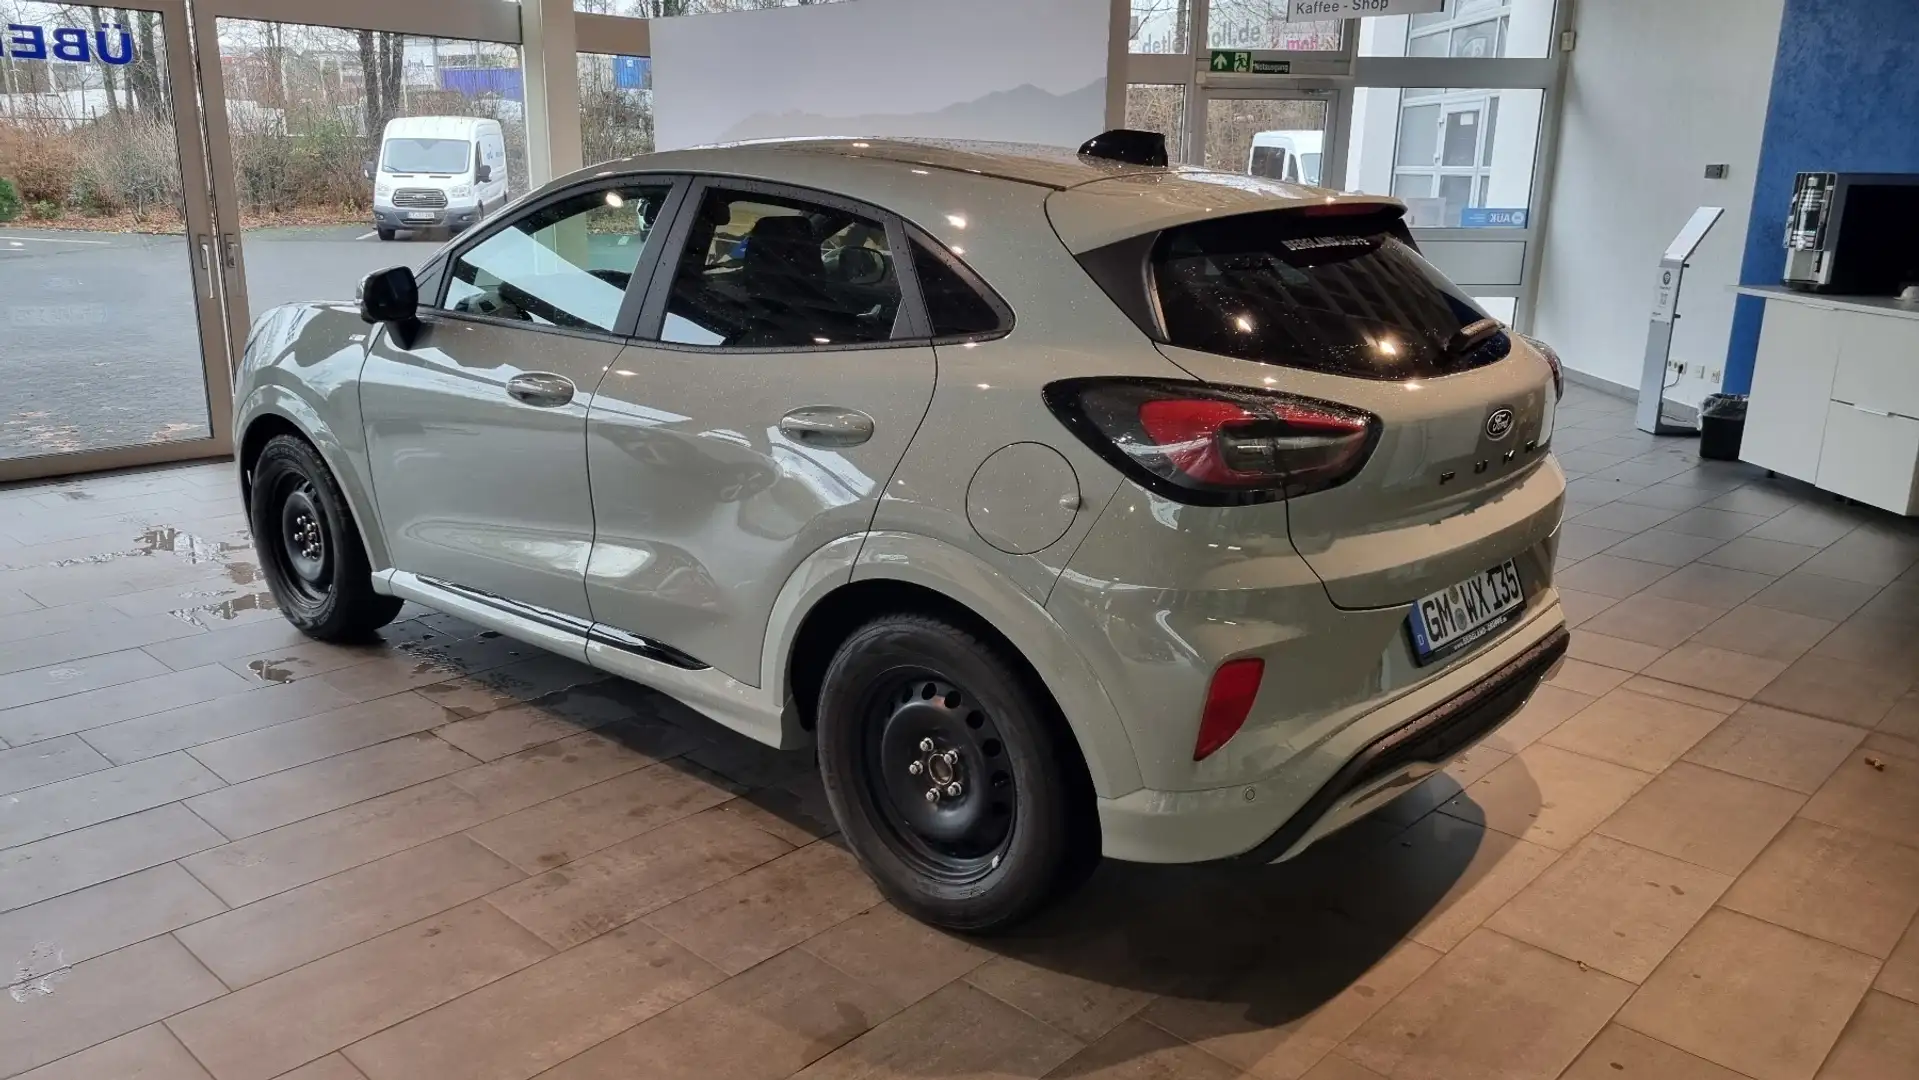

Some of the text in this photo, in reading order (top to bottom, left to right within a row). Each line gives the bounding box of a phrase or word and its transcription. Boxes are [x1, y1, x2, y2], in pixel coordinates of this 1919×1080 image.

[1296, 1, 1340, 15] Kaffee
[1352, 0, 1389, 11] Shop
[1492, 412, 1511, 432] Ford
[1422, 593, 1457, 642] GM
[1460, 576, 1490, 623] WX
[1486, 561, 1519, 610] 135
